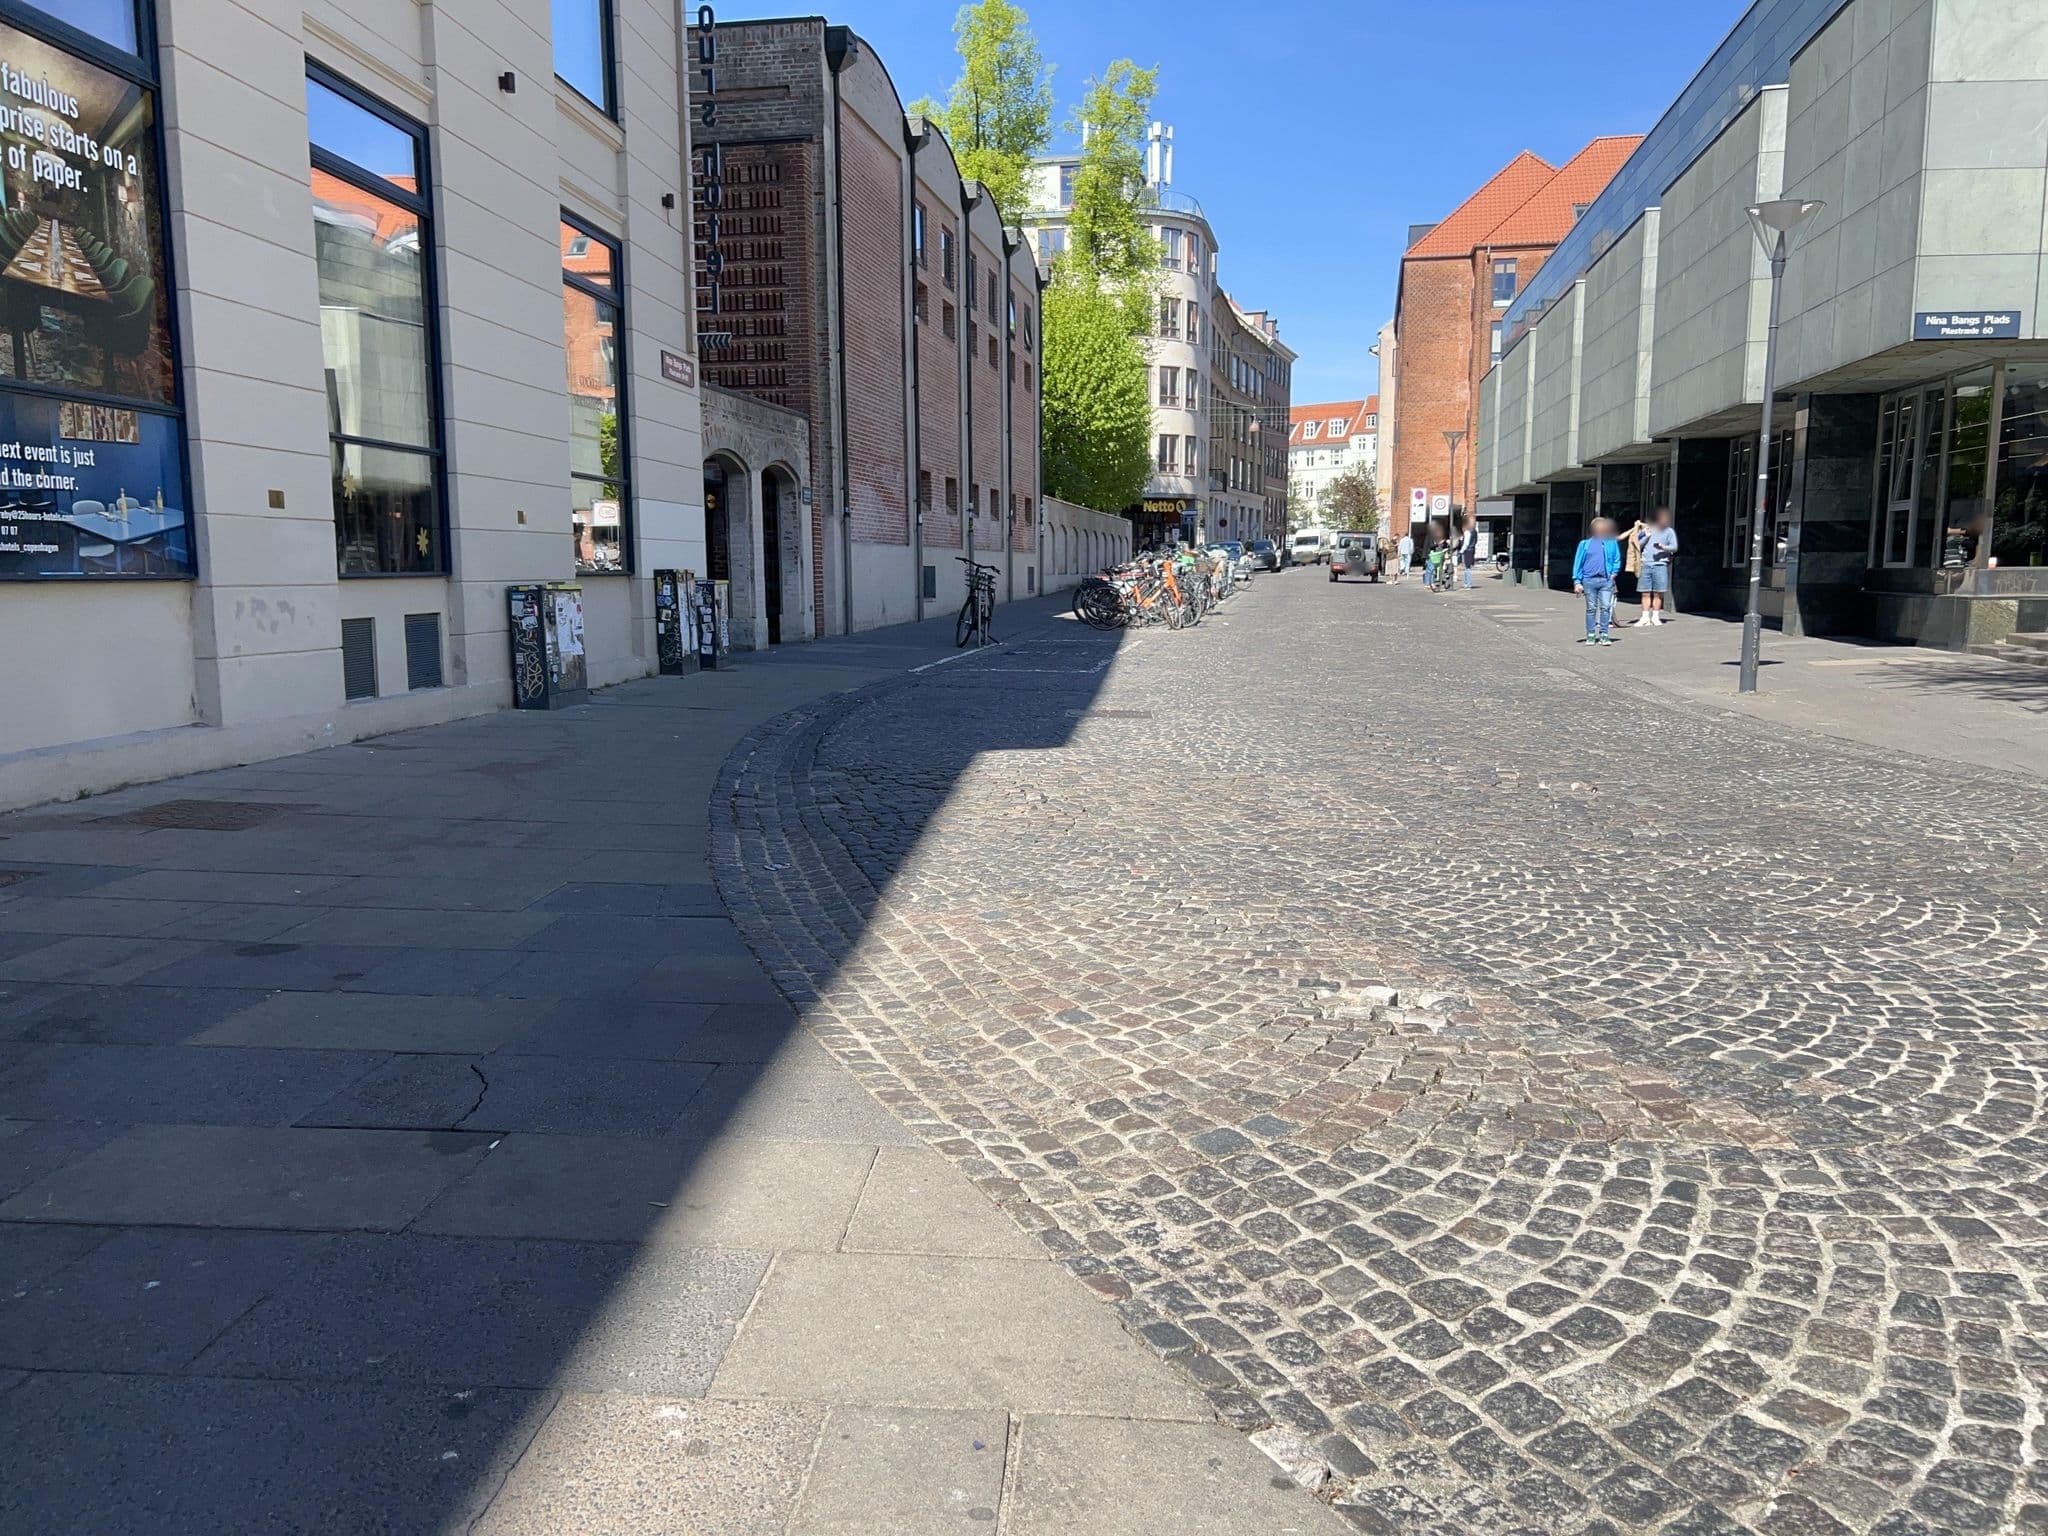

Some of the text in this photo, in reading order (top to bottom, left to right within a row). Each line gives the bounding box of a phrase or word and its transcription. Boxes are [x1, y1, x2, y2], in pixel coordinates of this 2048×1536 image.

[1, 62, 79, 119] fabulous
[49, 123, 99, 162] starts
[103, 145, 123, 171] on
[127, 154, 137, 176] a
[8, 143, 26, 172] of
[32, 153, 88, 193] paper.
[1925, 314, 2011, 327] Nina Bangs Plads
[1982, 326, 1994, 335] 60
[0, 441, 95, 468] ext event is just
[12, 468, 33, 488] the
[36, 473, 79, 491] corner.
[1143, 500, 1175, 513] Netto
